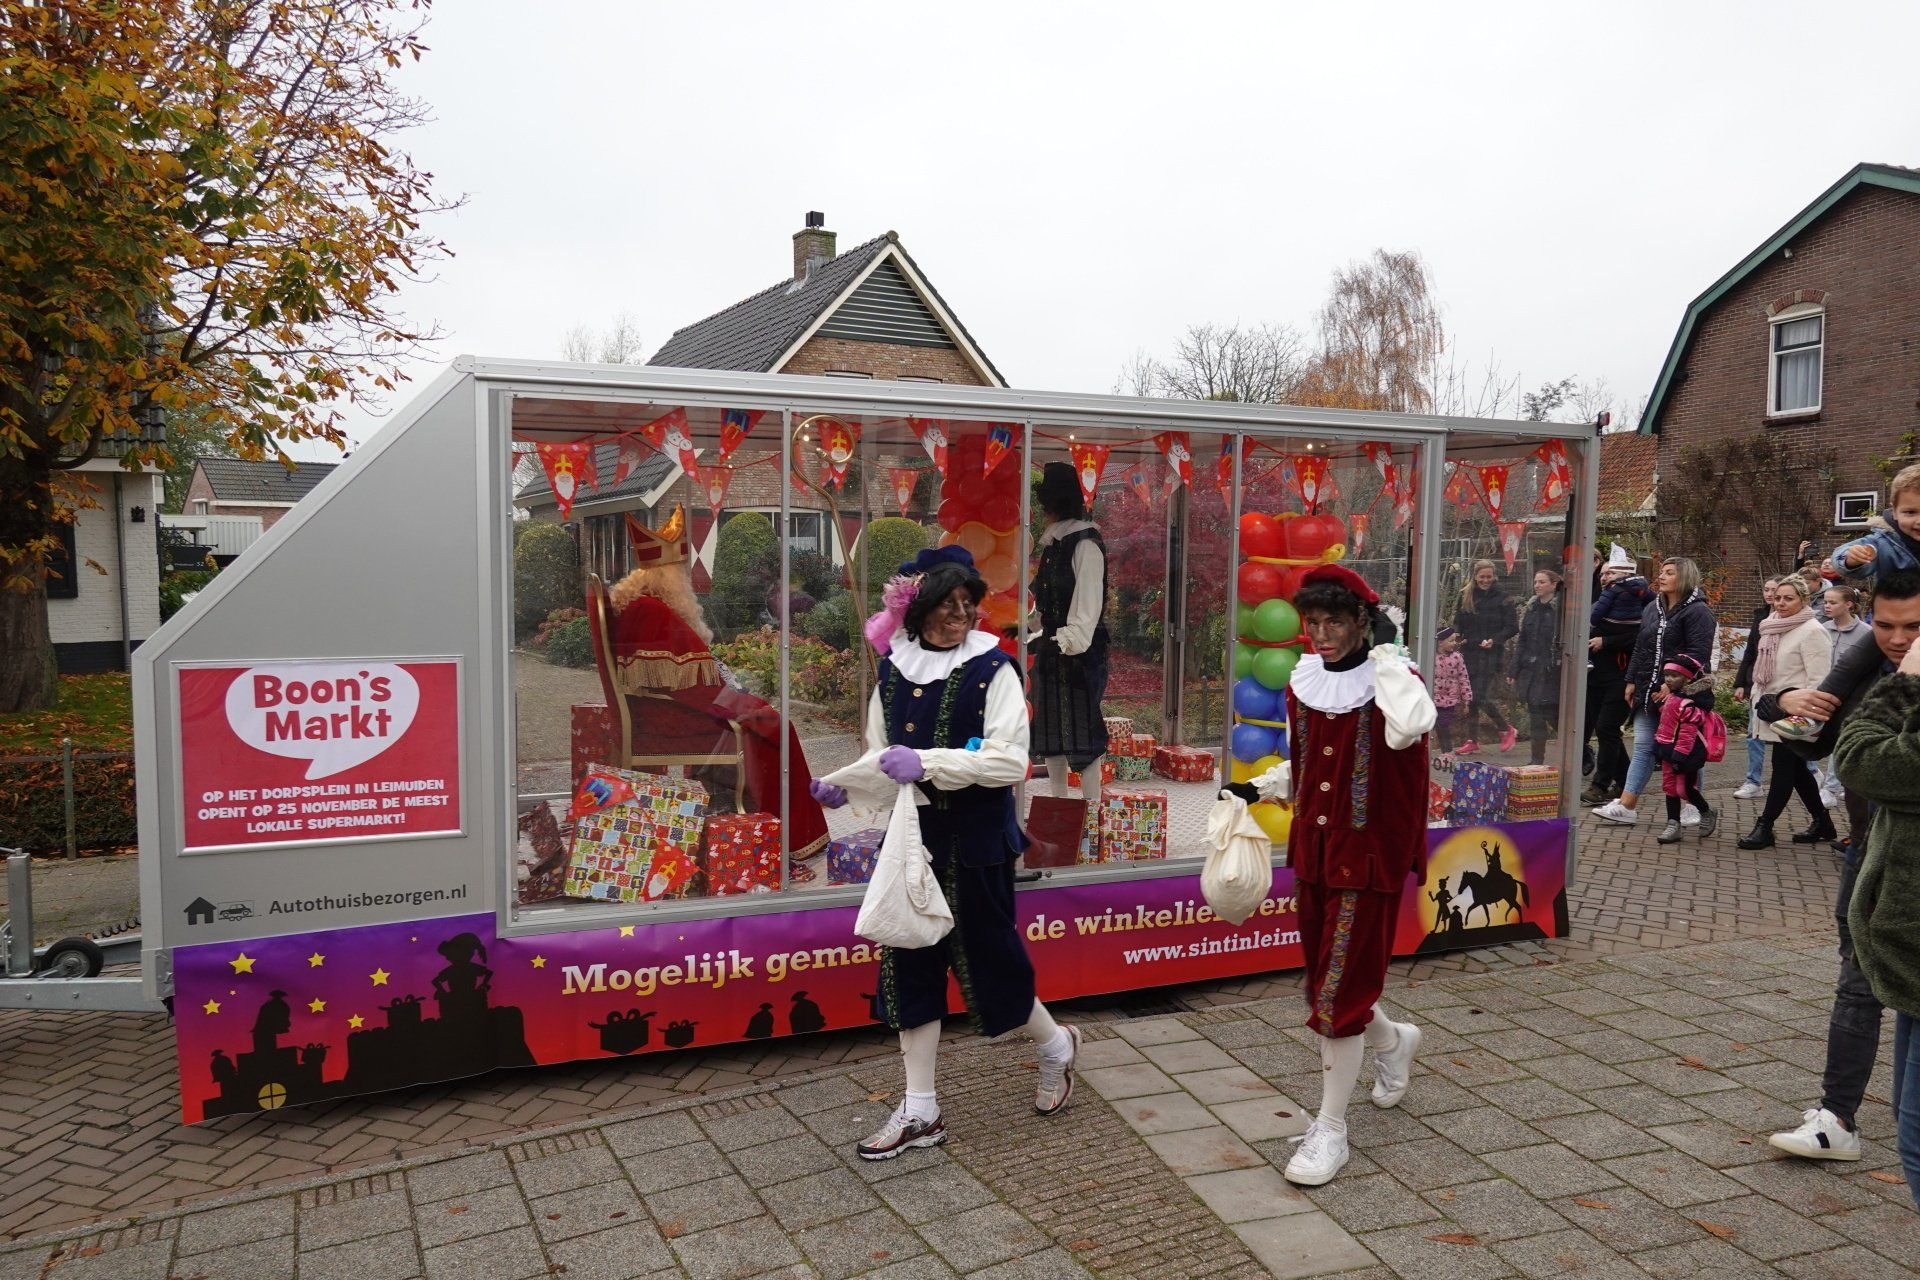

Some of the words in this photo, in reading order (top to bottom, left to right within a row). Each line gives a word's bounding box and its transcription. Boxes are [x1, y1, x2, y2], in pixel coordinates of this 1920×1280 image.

[253, 670, 393, 709] Boon's
[264, 705, 393, 742] Markt
[202, 790, 225, 803] OP
[228, 789, 258, 801] HET
[261, 783, 351, 800] DORPSPLEIN
[354, 783, 370, 794] IN
[373, 779, 445, 793] LEIMUIDEN
[197, 806, 248, 820] OPENT
[251, 804, 273, 817] OP
[277, 803, 297, 815] 25
[301, 798, 378, 814] NOVEMBER
[382, 797, 401, 809] DE
[404, 795, 450, 807] MEEST
[247, 819, 303, 833] LOKALE
[307, 812, 406, 829] SUPERMARKT!
[268, 883, 467, 915] Autothuisbezorgen.nl
[561, 949, 755, 997] Mogelijk
[1026, 914, 1067, 941] de
[1074, 896, 1299, 936] winkelieere
